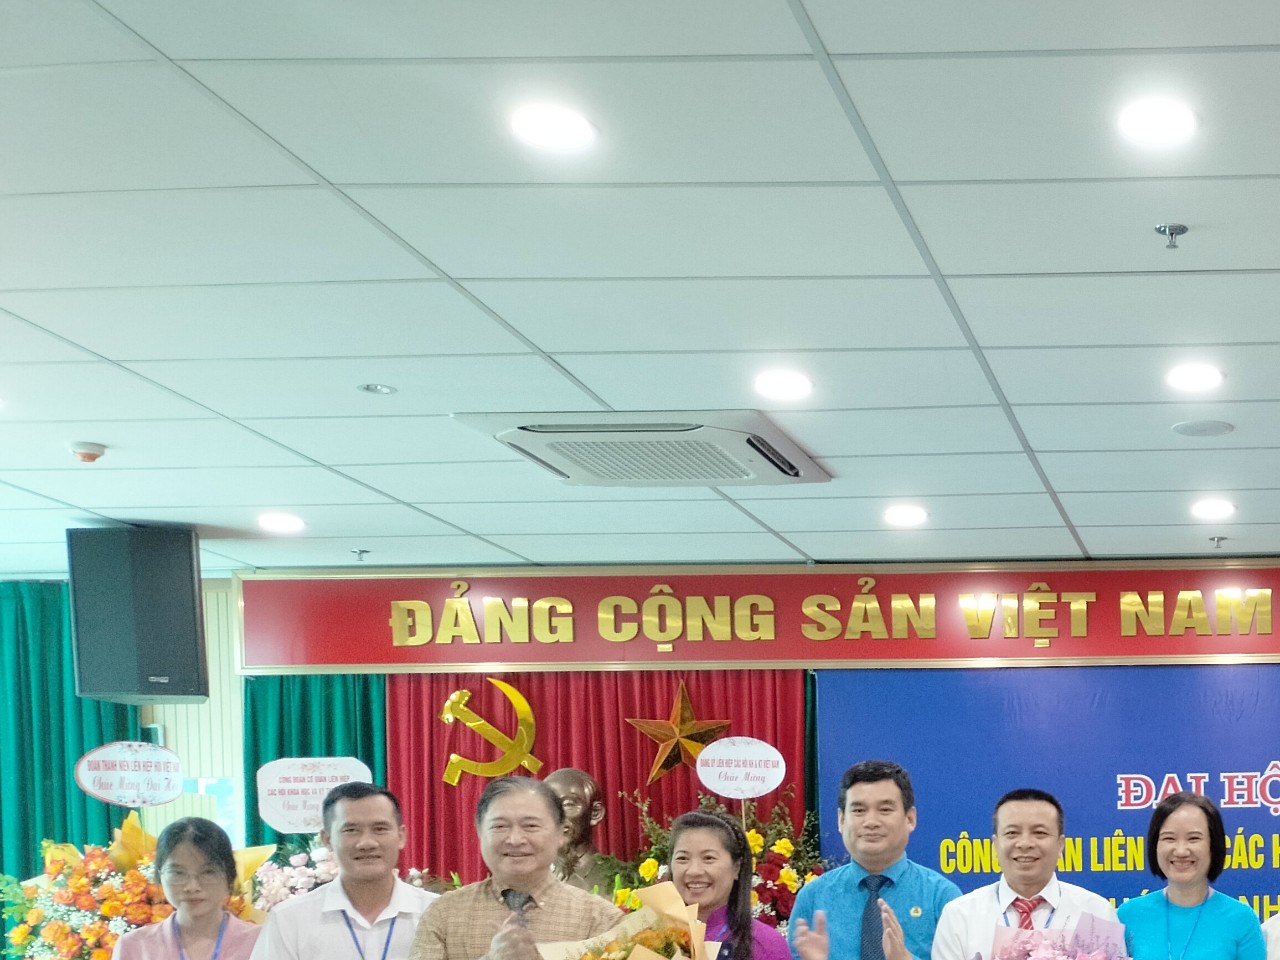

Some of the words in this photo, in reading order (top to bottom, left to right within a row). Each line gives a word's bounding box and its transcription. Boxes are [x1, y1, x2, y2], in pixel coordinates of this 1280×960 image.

[389, 580, 574, 648] ĐẢNG
[597, 584, 776, 653] CỘNG
[801, 577, 937, 642] SẢN
[957, 582, 1097, 648] VIỆT
[1119, 588, 1274, 638] NAM
[1090, 829, 1145, 872] LIÊN
